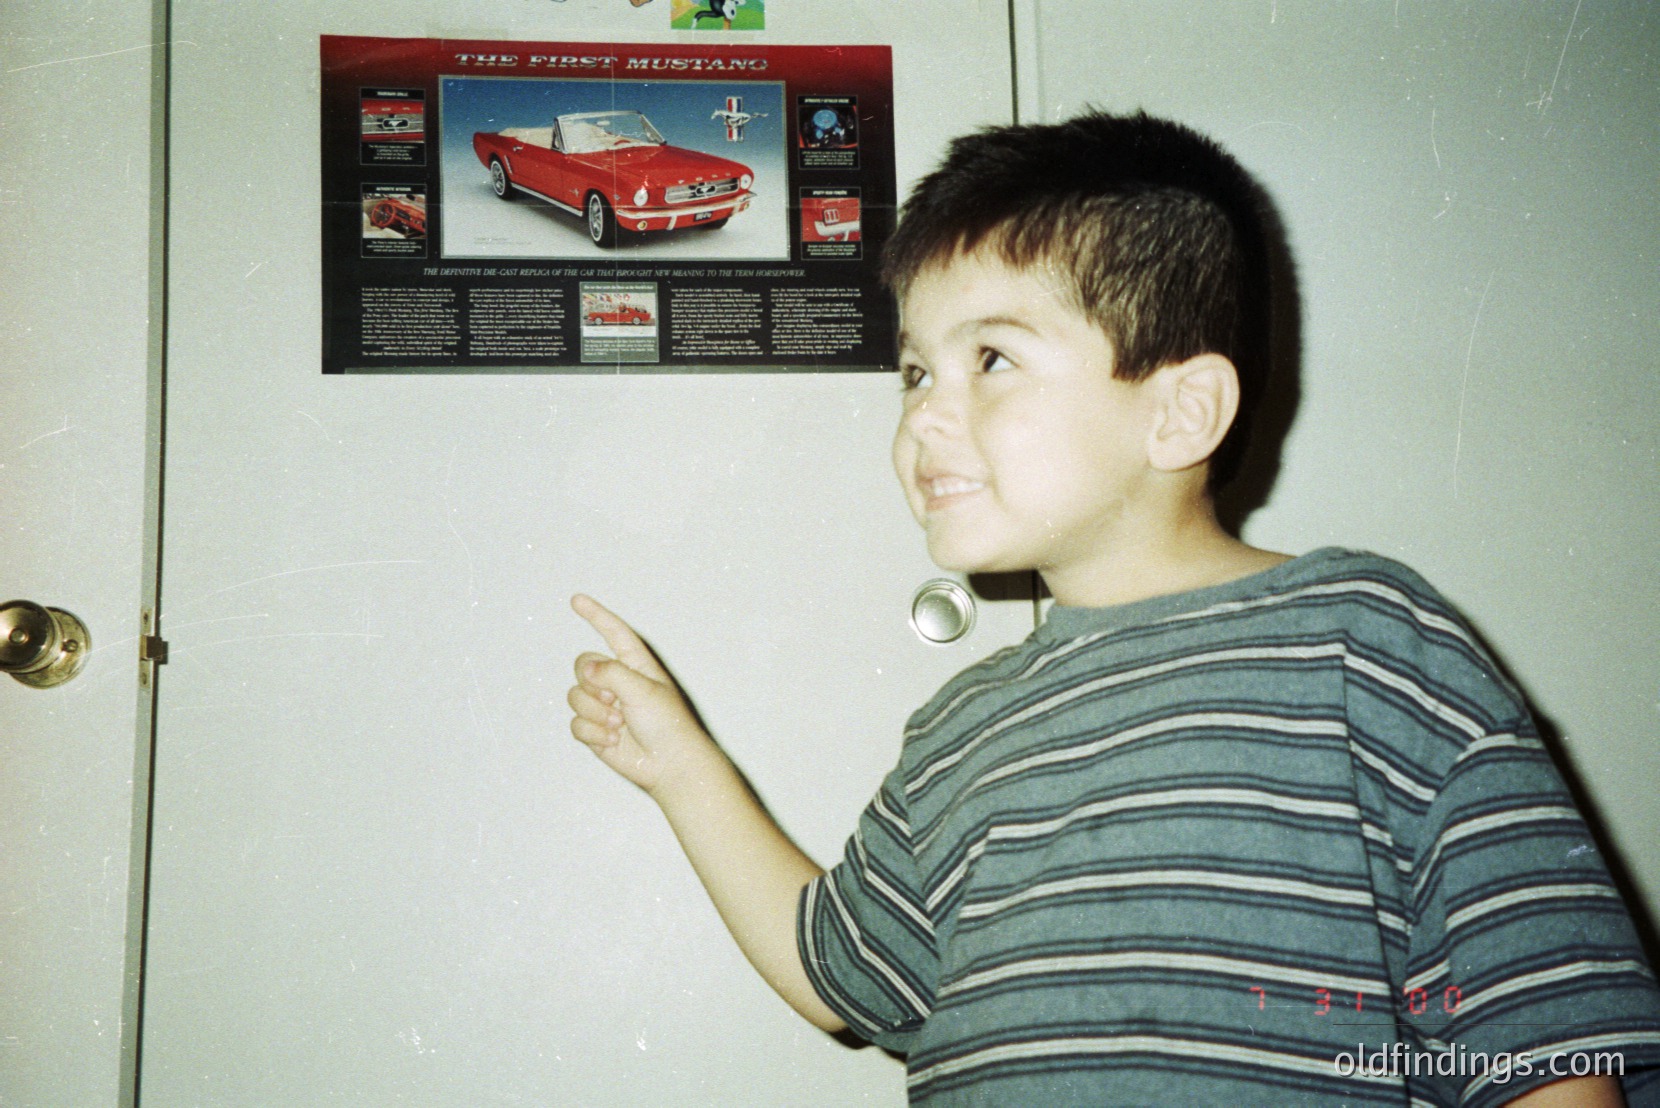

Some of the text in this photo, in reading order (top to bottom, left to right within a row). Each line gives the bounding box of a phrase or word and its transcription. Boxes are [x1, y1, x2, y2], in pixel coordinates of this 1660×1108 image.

[455, 53, 769, 71] THE FIRST MUSTANG
[423, 267, 439, 276] THE
[440, 267, 482, 276] DEFINITIVE
[483, 267, 519, 276] DIE-CAST
[519, 268, 550, 276] REPLICA
[551, 268, 563, 276] OF
[563, 268, 579, 276] THE
[580, 268, 594, 277] CAR
[597, 268, 615, 277] THAT
[616, 268, 653, 277] BROUGHT
[655, 268, 671, 277] NEW
[671, 268, 705, 277] MEANING
[706, 269, 717, 277] TO
[718, 269, 734, 277] THE
[735, 269, 755, 277] TERM
